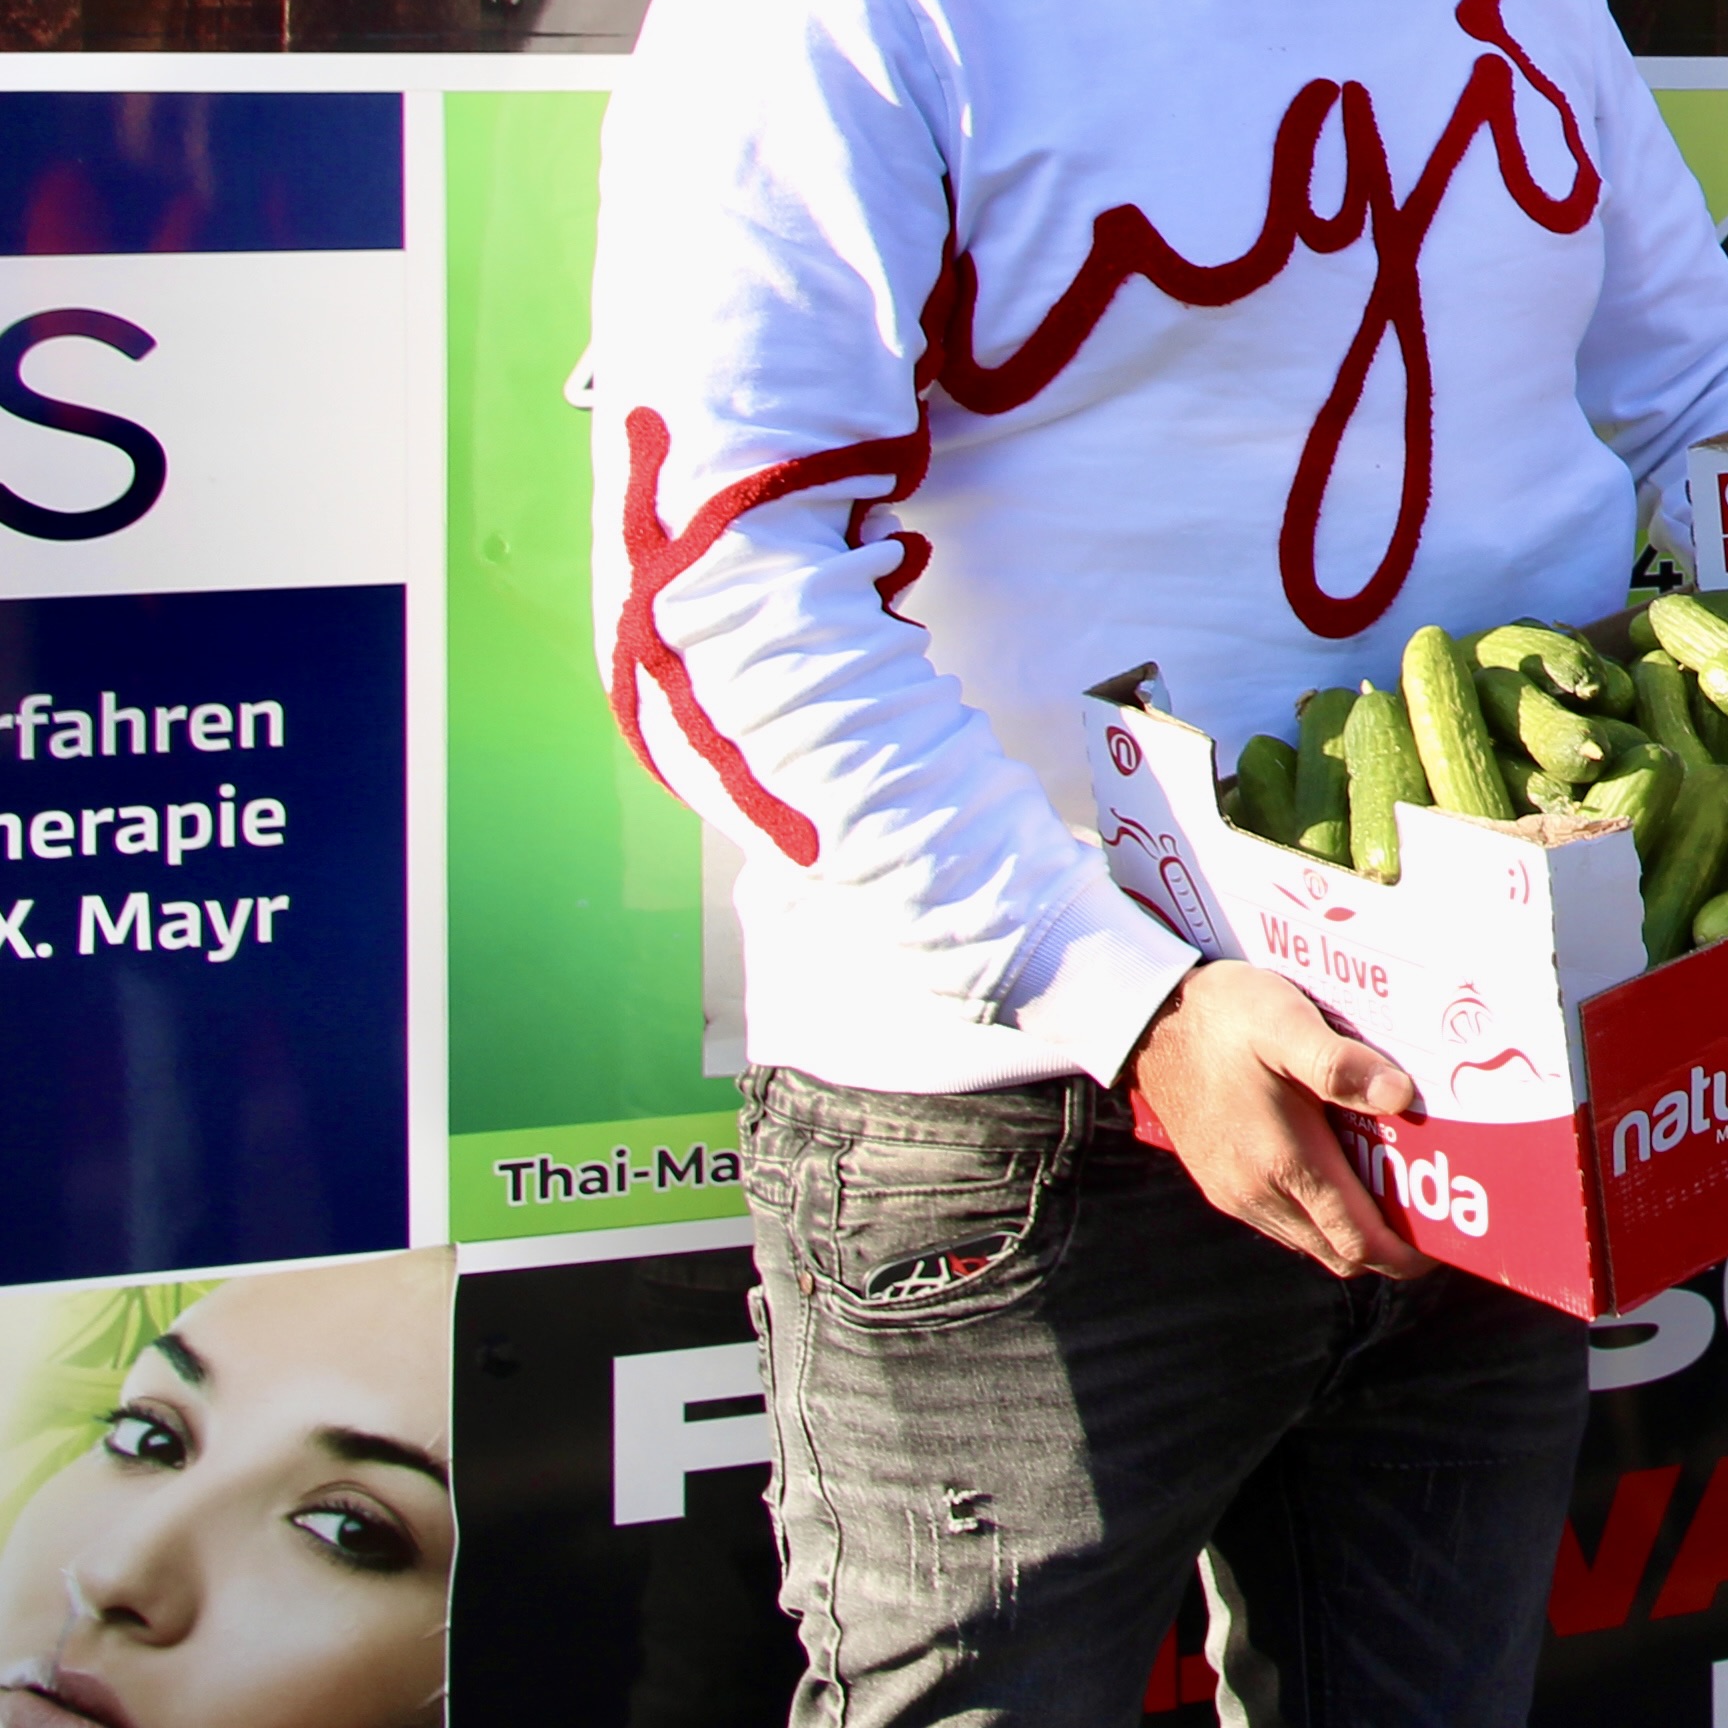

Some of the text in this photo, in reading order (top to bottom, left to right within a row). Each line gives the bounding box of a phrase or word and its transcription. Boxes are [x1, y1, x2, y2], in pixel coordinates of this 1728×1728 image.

[78, 891, 291, 963] Mayr
[1259, 911, 1390, 999] We love
[496, 1142, 743, 1205] Thai-Ma
